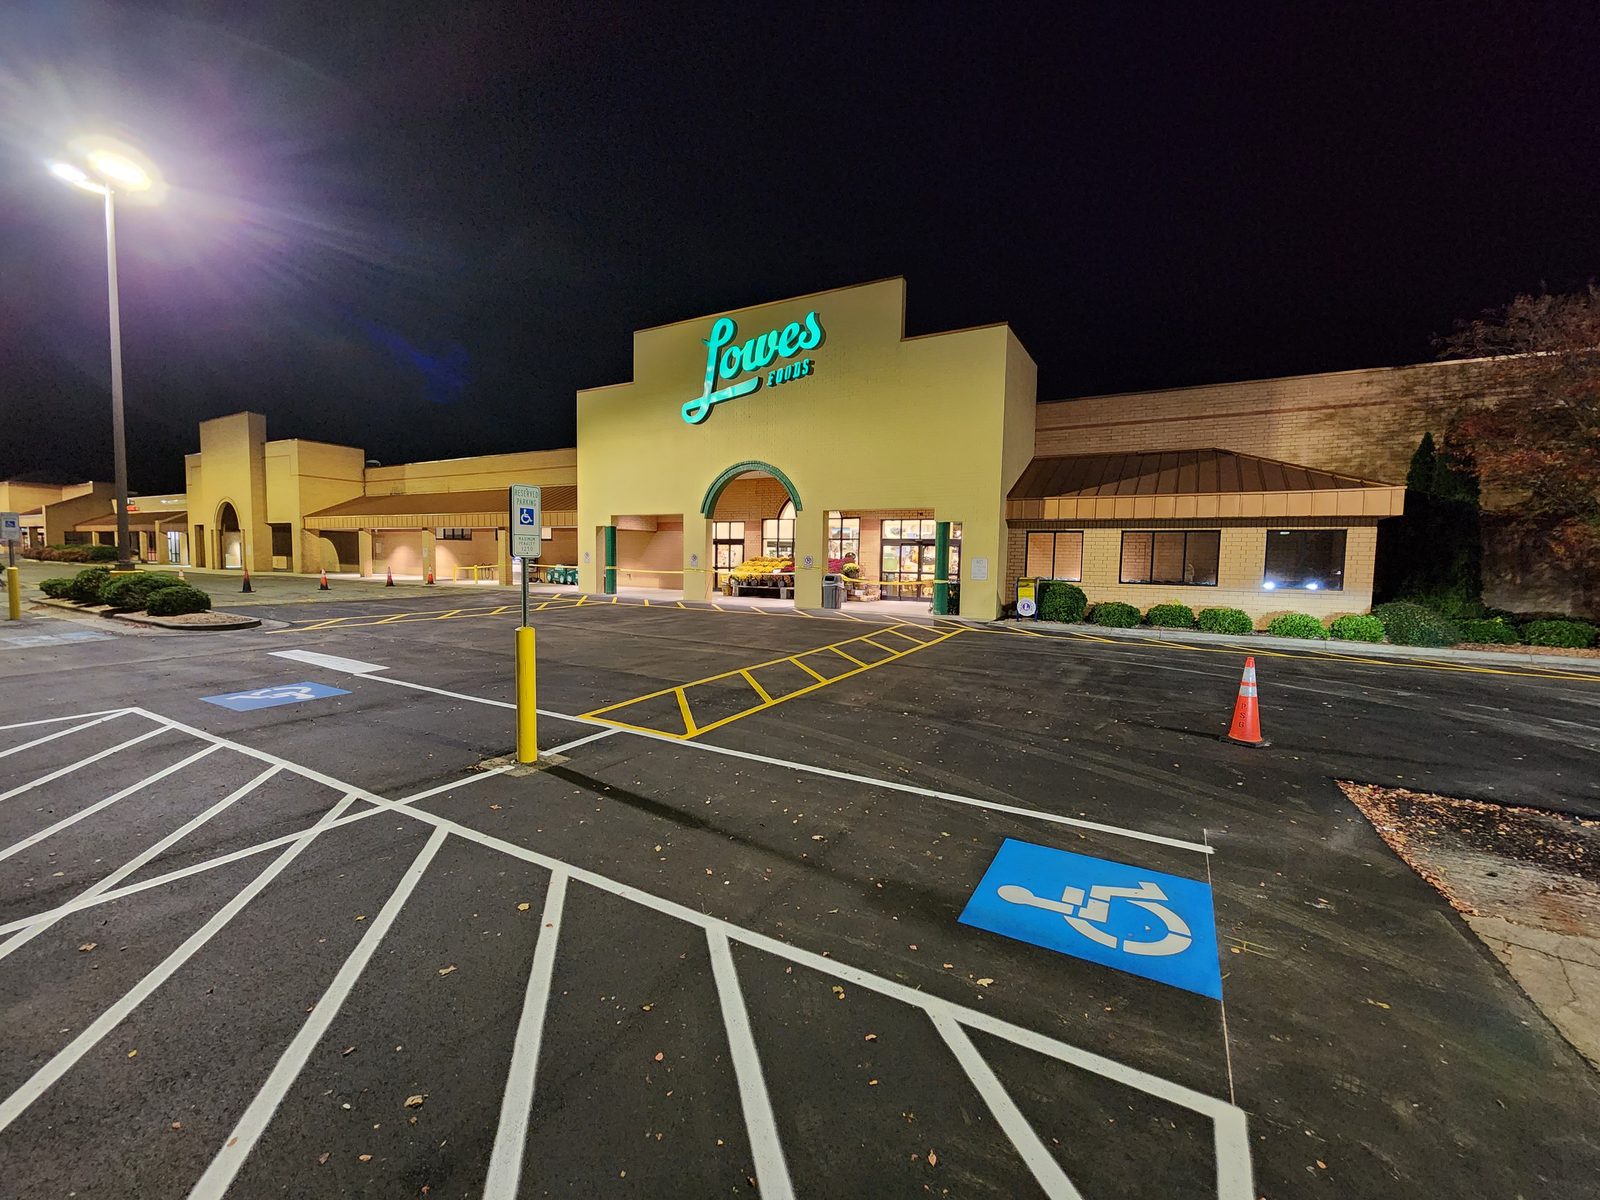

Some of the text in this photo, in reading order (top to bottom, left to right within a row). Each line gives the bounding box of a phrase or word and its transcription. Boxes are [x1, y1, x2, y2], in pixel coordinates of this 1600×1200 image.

[680, 311, 825, 424] Lowes
[766, 358, 814, 388] FOODS
[514, 489, 538, 498] RESERVED
[516, 498, 537, 507] PARKING
